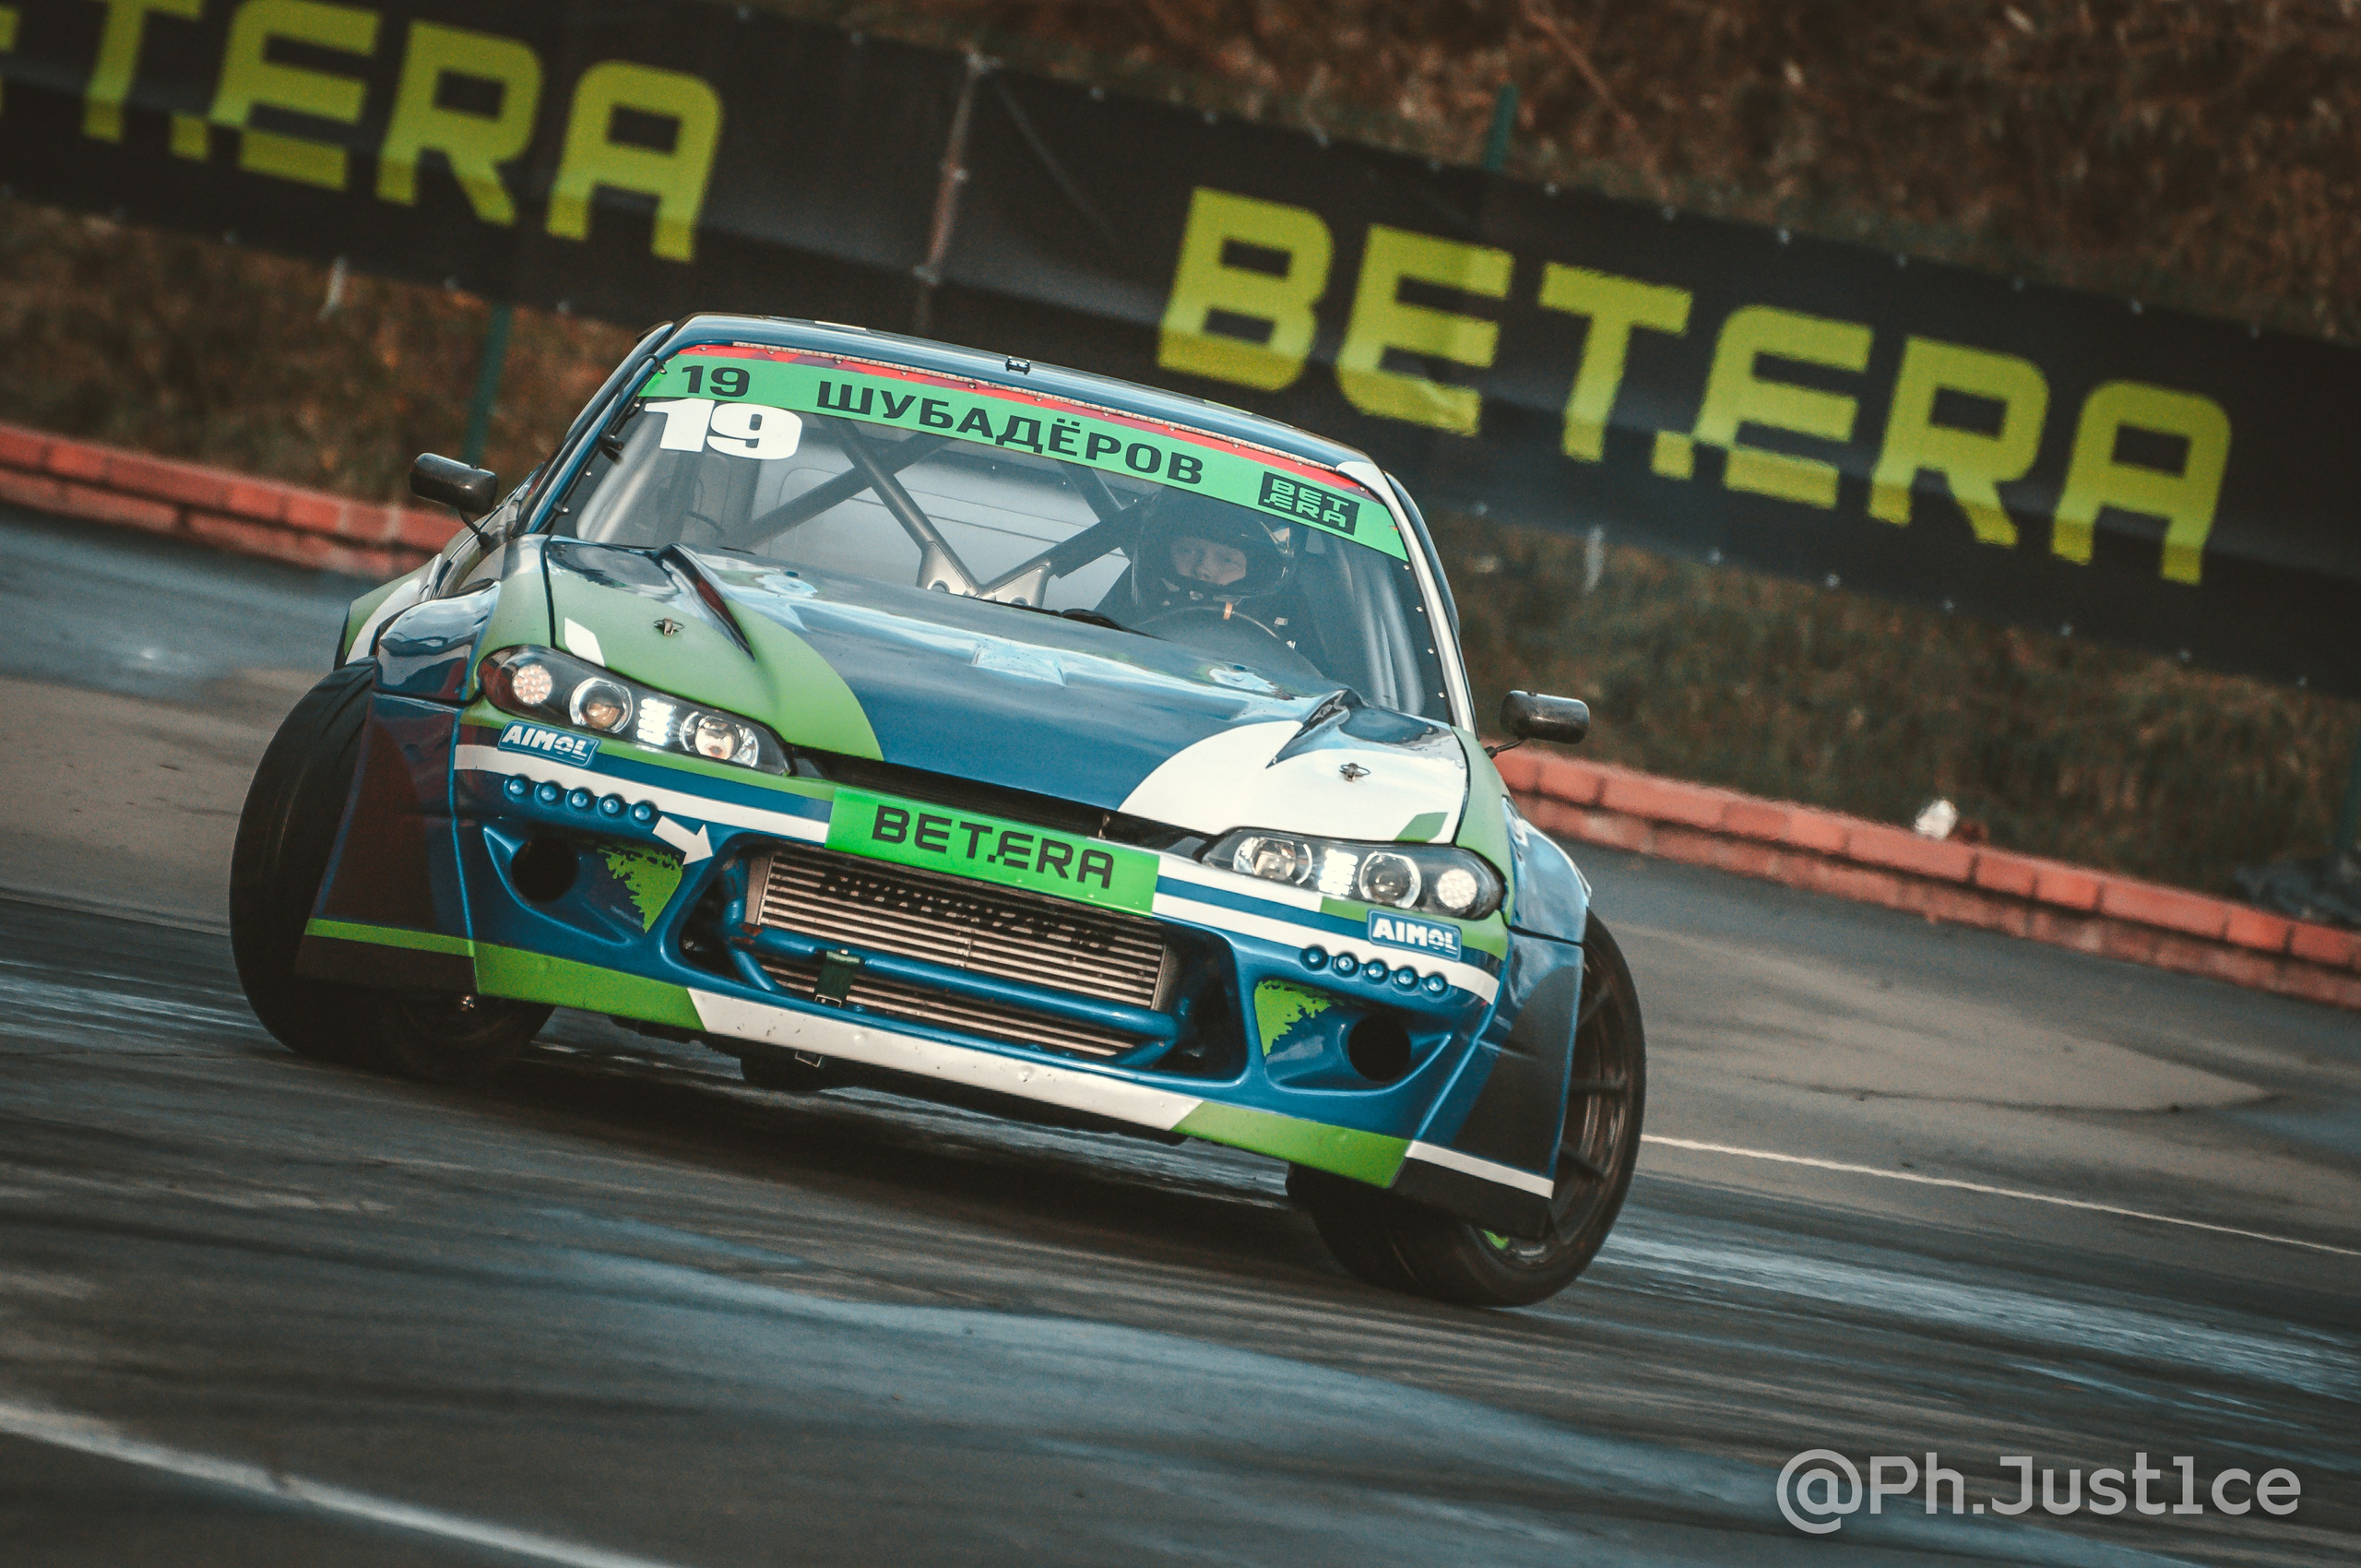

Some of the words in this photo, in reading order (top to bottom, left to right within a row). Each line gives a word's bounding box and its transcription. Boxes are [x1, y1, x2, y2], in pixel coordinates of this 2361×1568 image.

[0, 0, 723, 263] T.ERA
[682, 365, 750, 397] 19
[644, 398, 802, 459] 19
[816, 381, 1204, 485] ШУБАДЁРОВ
[1272, 479, 1348, 512] BET
[502, 725, 587, 761] AIMOL
[1372, 918, 1457, 955] AIMOL
